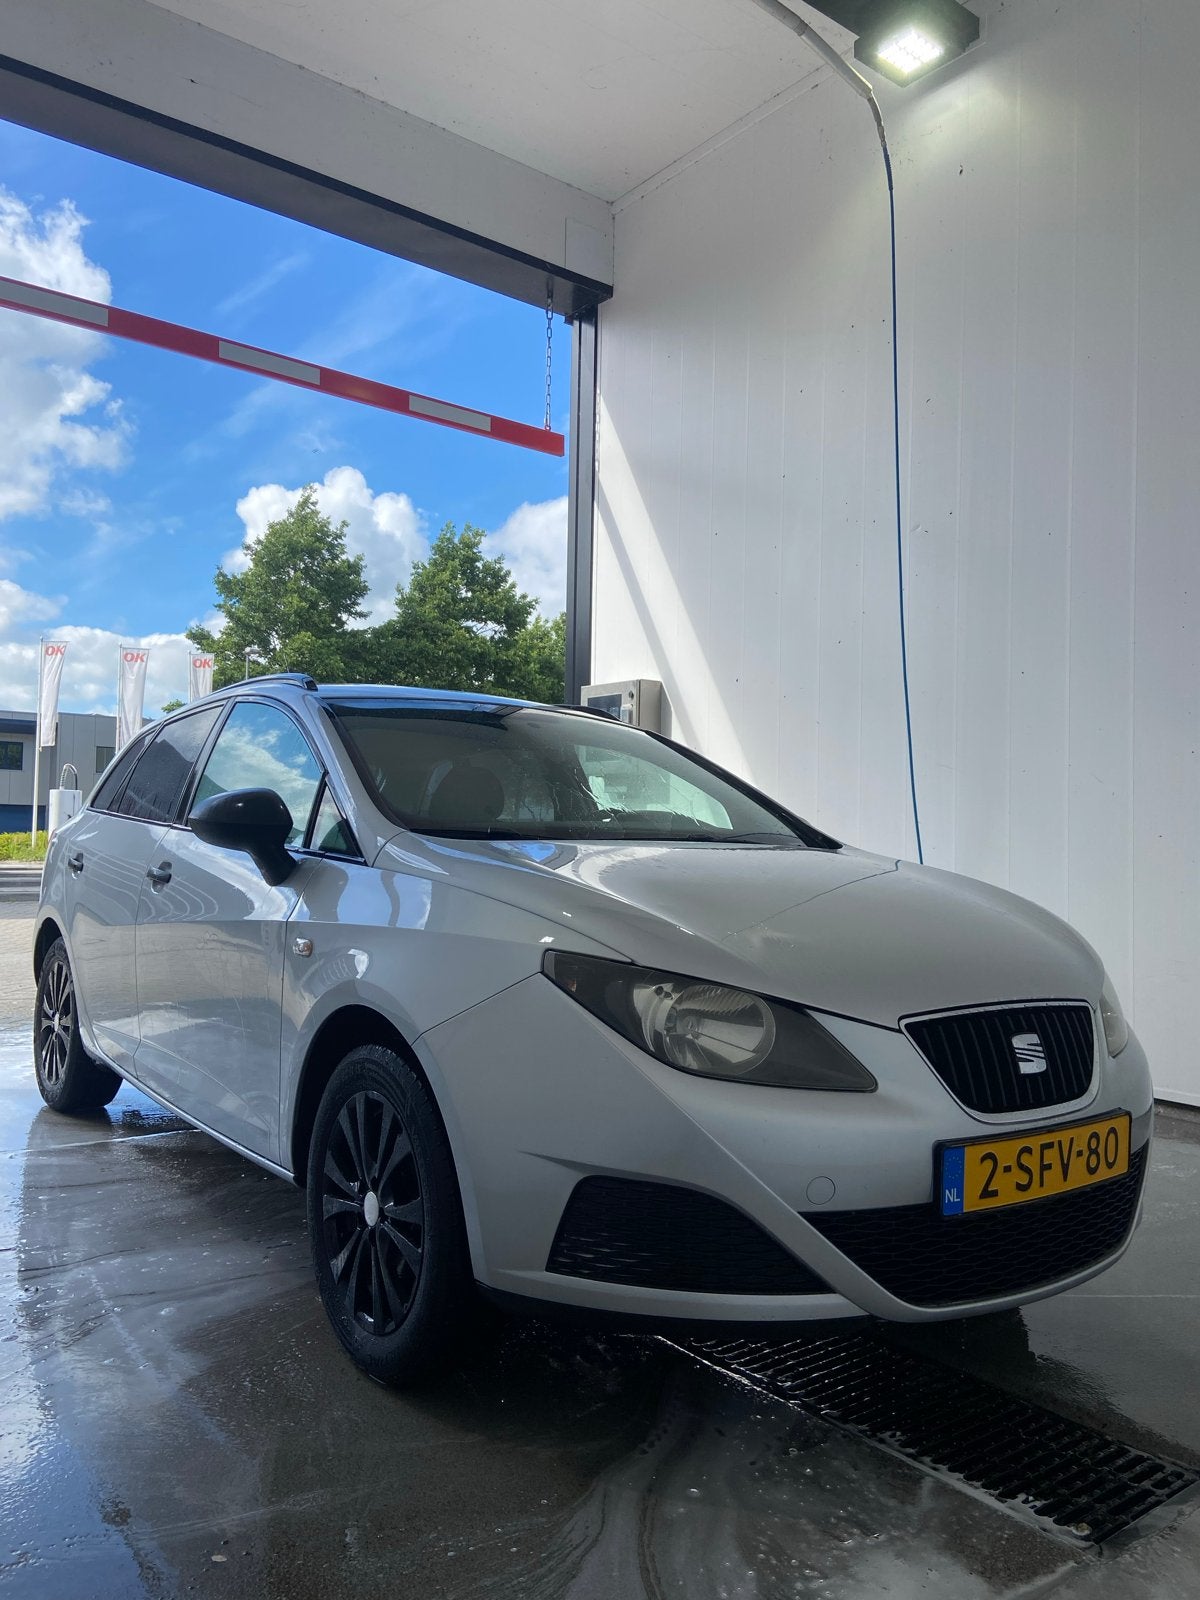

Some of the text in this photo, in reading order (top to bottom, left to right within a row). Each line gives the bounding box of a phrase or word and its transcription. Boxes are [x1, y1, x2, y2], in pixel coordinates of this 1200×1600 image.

[45, 645, 65, 657] OK
[123, 652, 146, 663] OK
[192, 658, 212, 669] OK
[979, 1126, 1119, 1200] 2-SFV-80
[945, 1189, 961, 1203] NL
